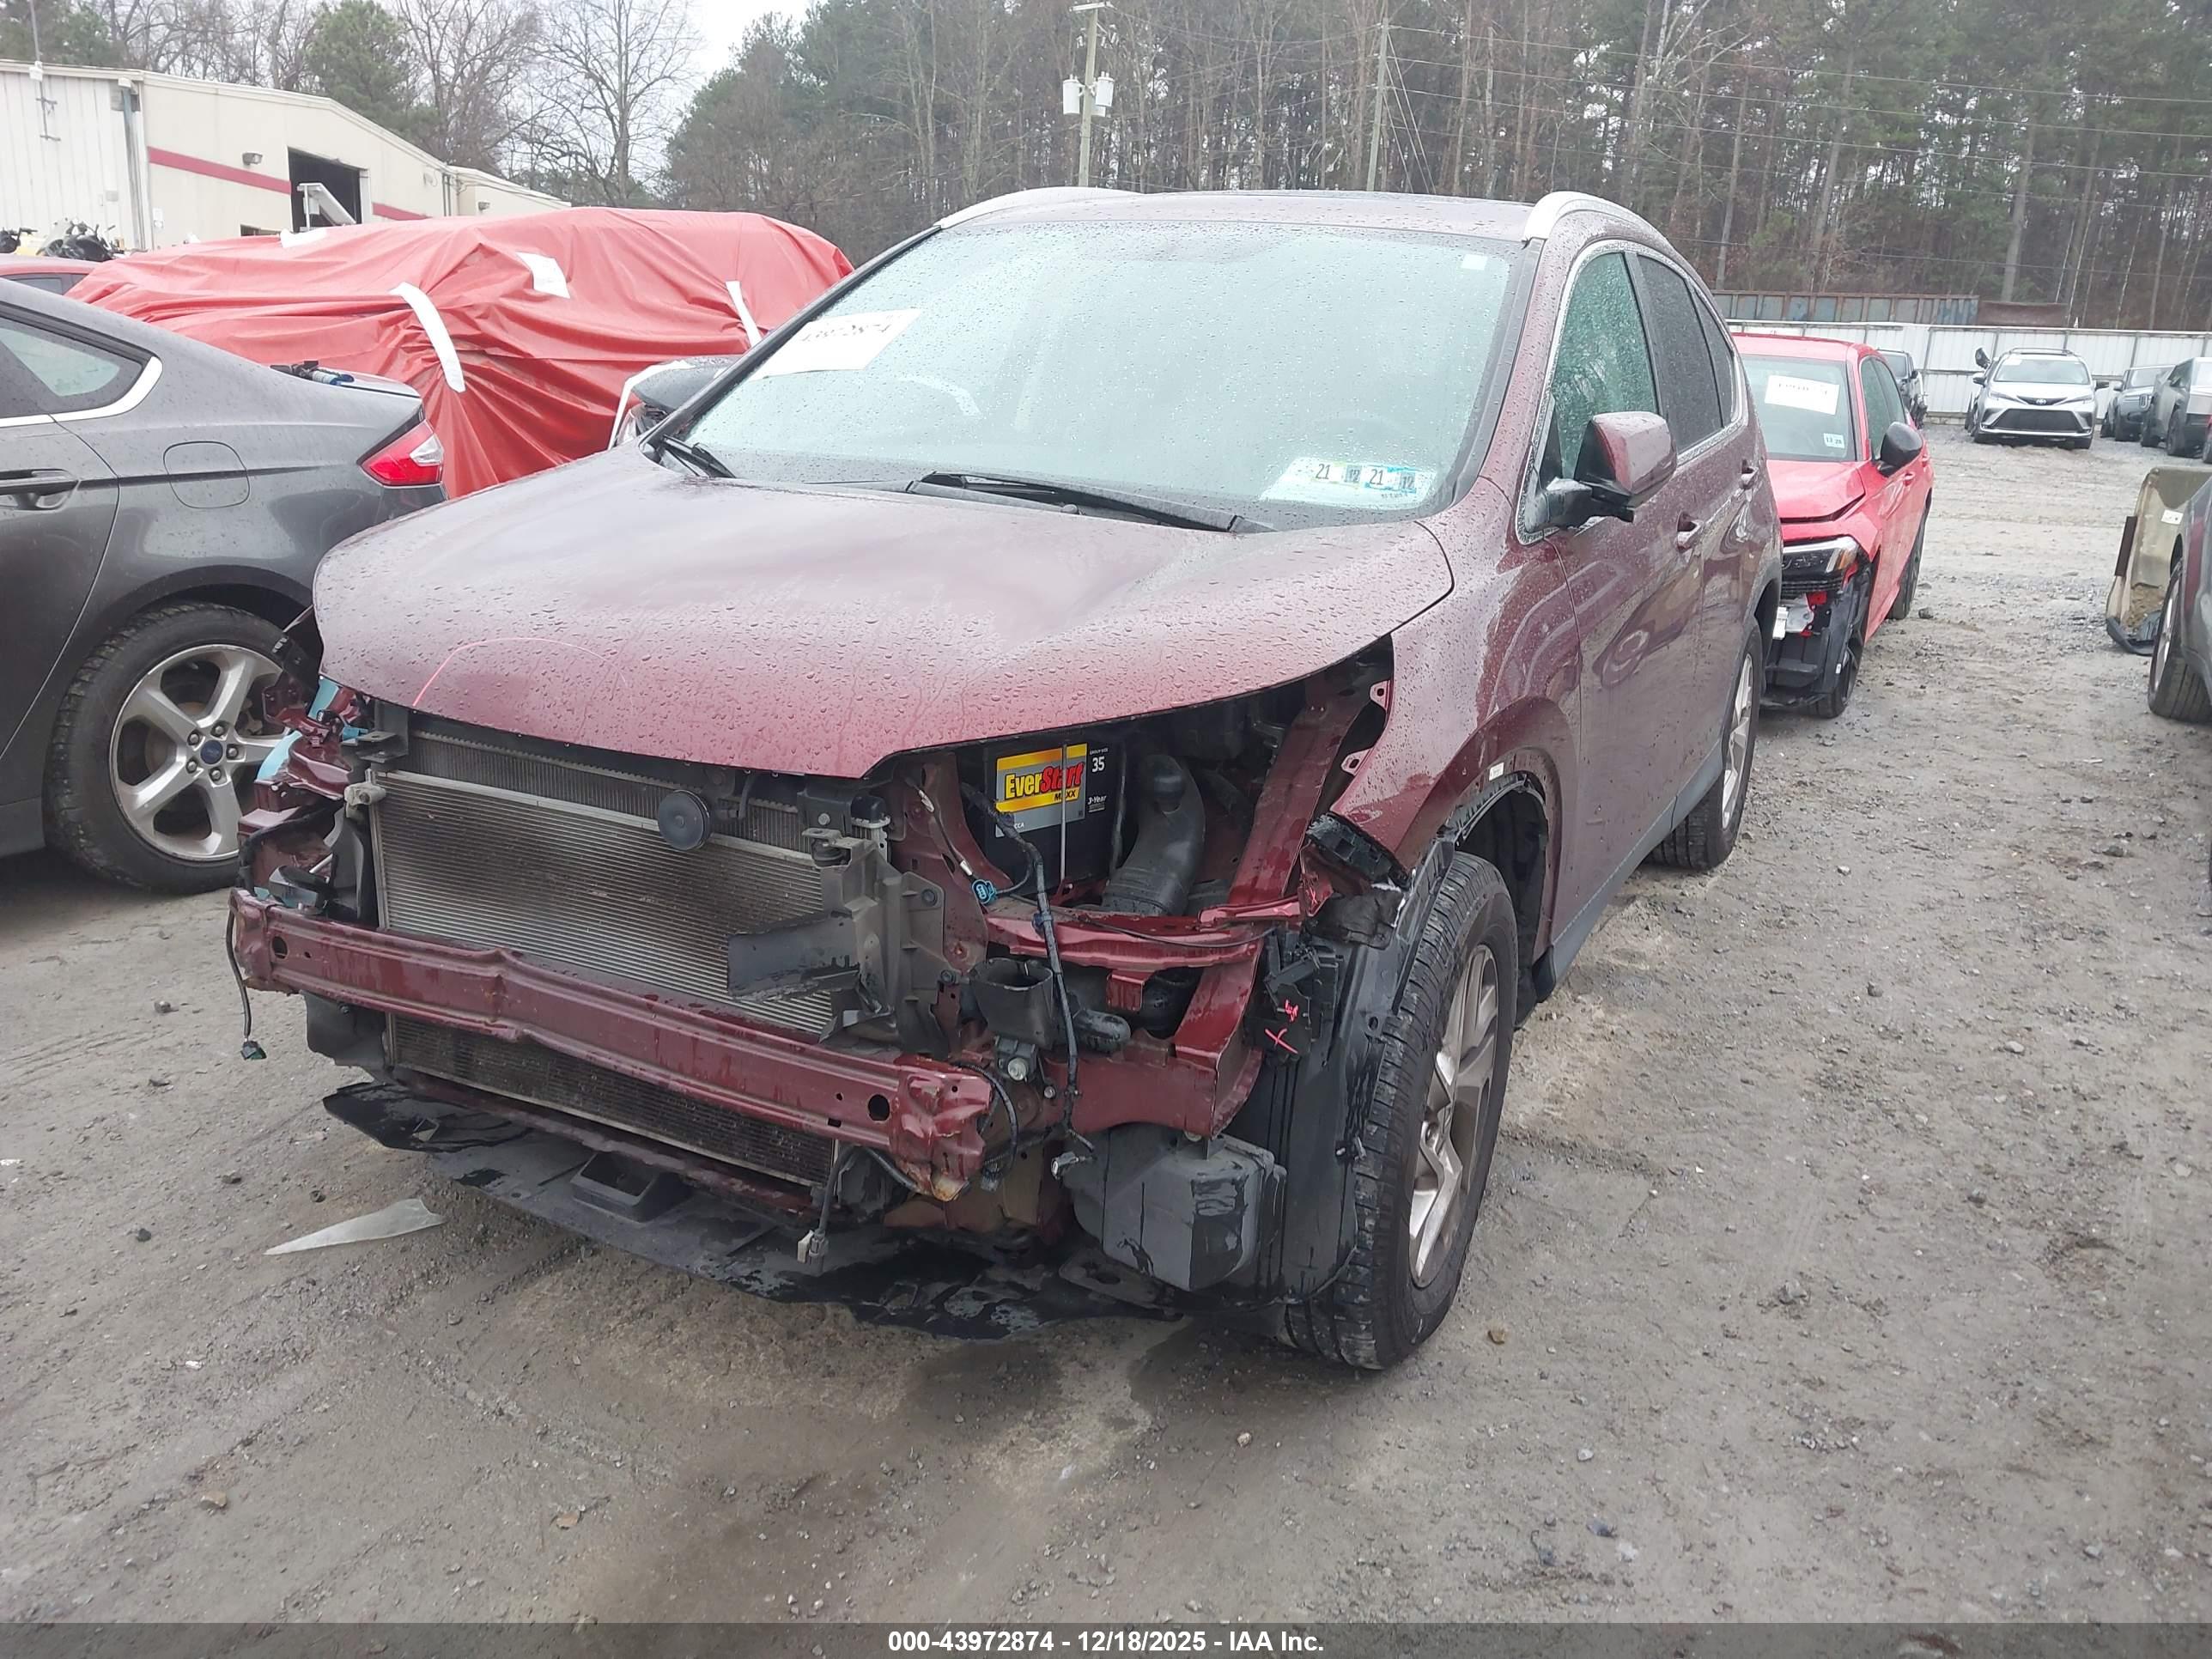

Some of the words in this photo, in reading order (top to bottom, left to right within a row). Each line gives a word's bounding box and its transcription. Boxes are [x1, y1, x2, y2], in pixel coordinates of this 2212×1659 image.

[1315, 463, 1331, 480] 21
[1369, 468, 1384, 486] 21
[1091, 756, 1105, 772] 35
[1054, 789, 1077, 802] MXX
